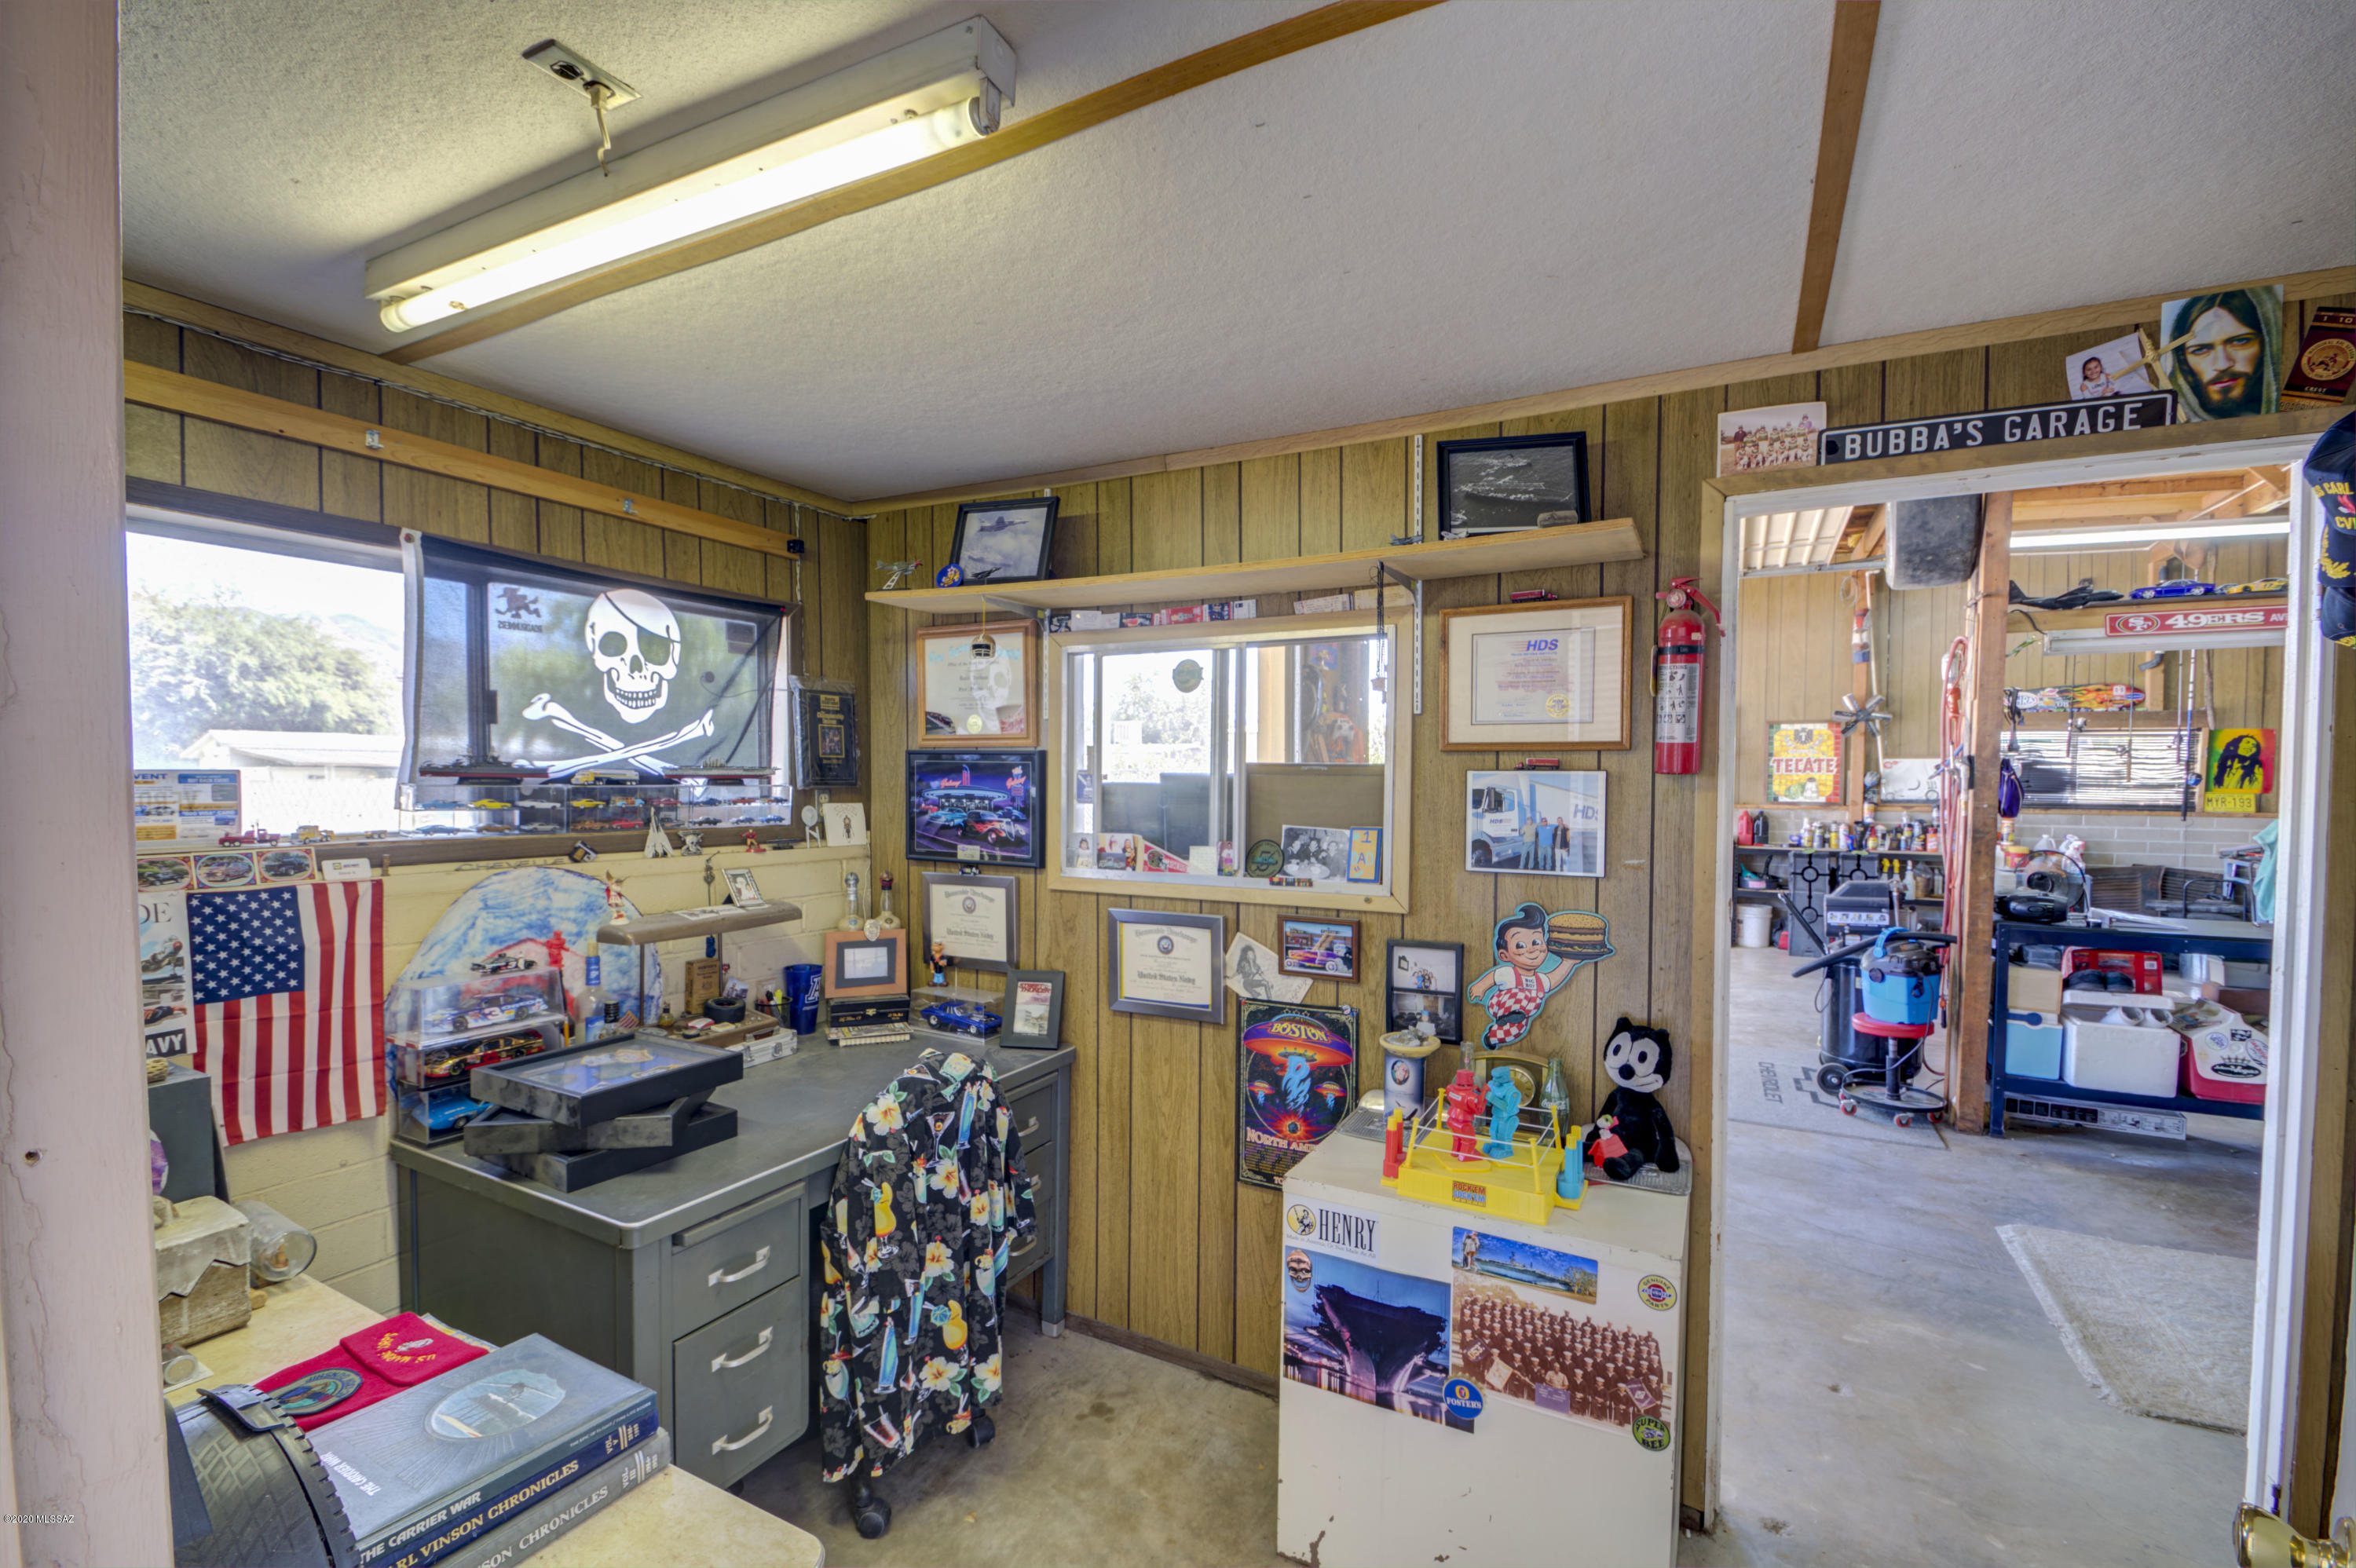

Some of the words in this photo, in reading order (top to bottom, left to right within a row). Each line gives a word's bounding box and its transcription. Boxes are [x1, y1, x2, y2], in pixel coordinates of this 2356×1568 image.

[1844, 419, 1985, 461] BUBBA'S
[2004, 403, 2143, 443] GARAGE
[2322, 481, 2354, 496] CARL
[2164, 611, 2266, 629] 49ERS
[1526, 638, 1559, 652] HDS
[1771, 758, 1837, 774] TECATE
[2207, 797, 2252, 808] MYR-193
[1351, 852, 1374, 865] DAD
[484, 1007, 503, 1020] 3
[1271, 1022, 1328, 1042] BOSTON
[145, 1033, 184, 1054] AVY
[1246, 1127, 1289, 1149] NORTH
[1319, 1208, 1376, 1252] HENRY
[1635, 1418, 1666, 1432] SUPER
[1641, 1438, 1664, 1449] BEE
[487, 1460, 580, 1519] CHRONICLES
[518, 1485, 609, 1550] CHRONICLES
[360, 1545, 386, 1565] THE
[388, 1511, 448, 1548] CARRIER
[449, 1491, 481, 1515] WAR
[419, 1513, 484, 1558] VINSON
